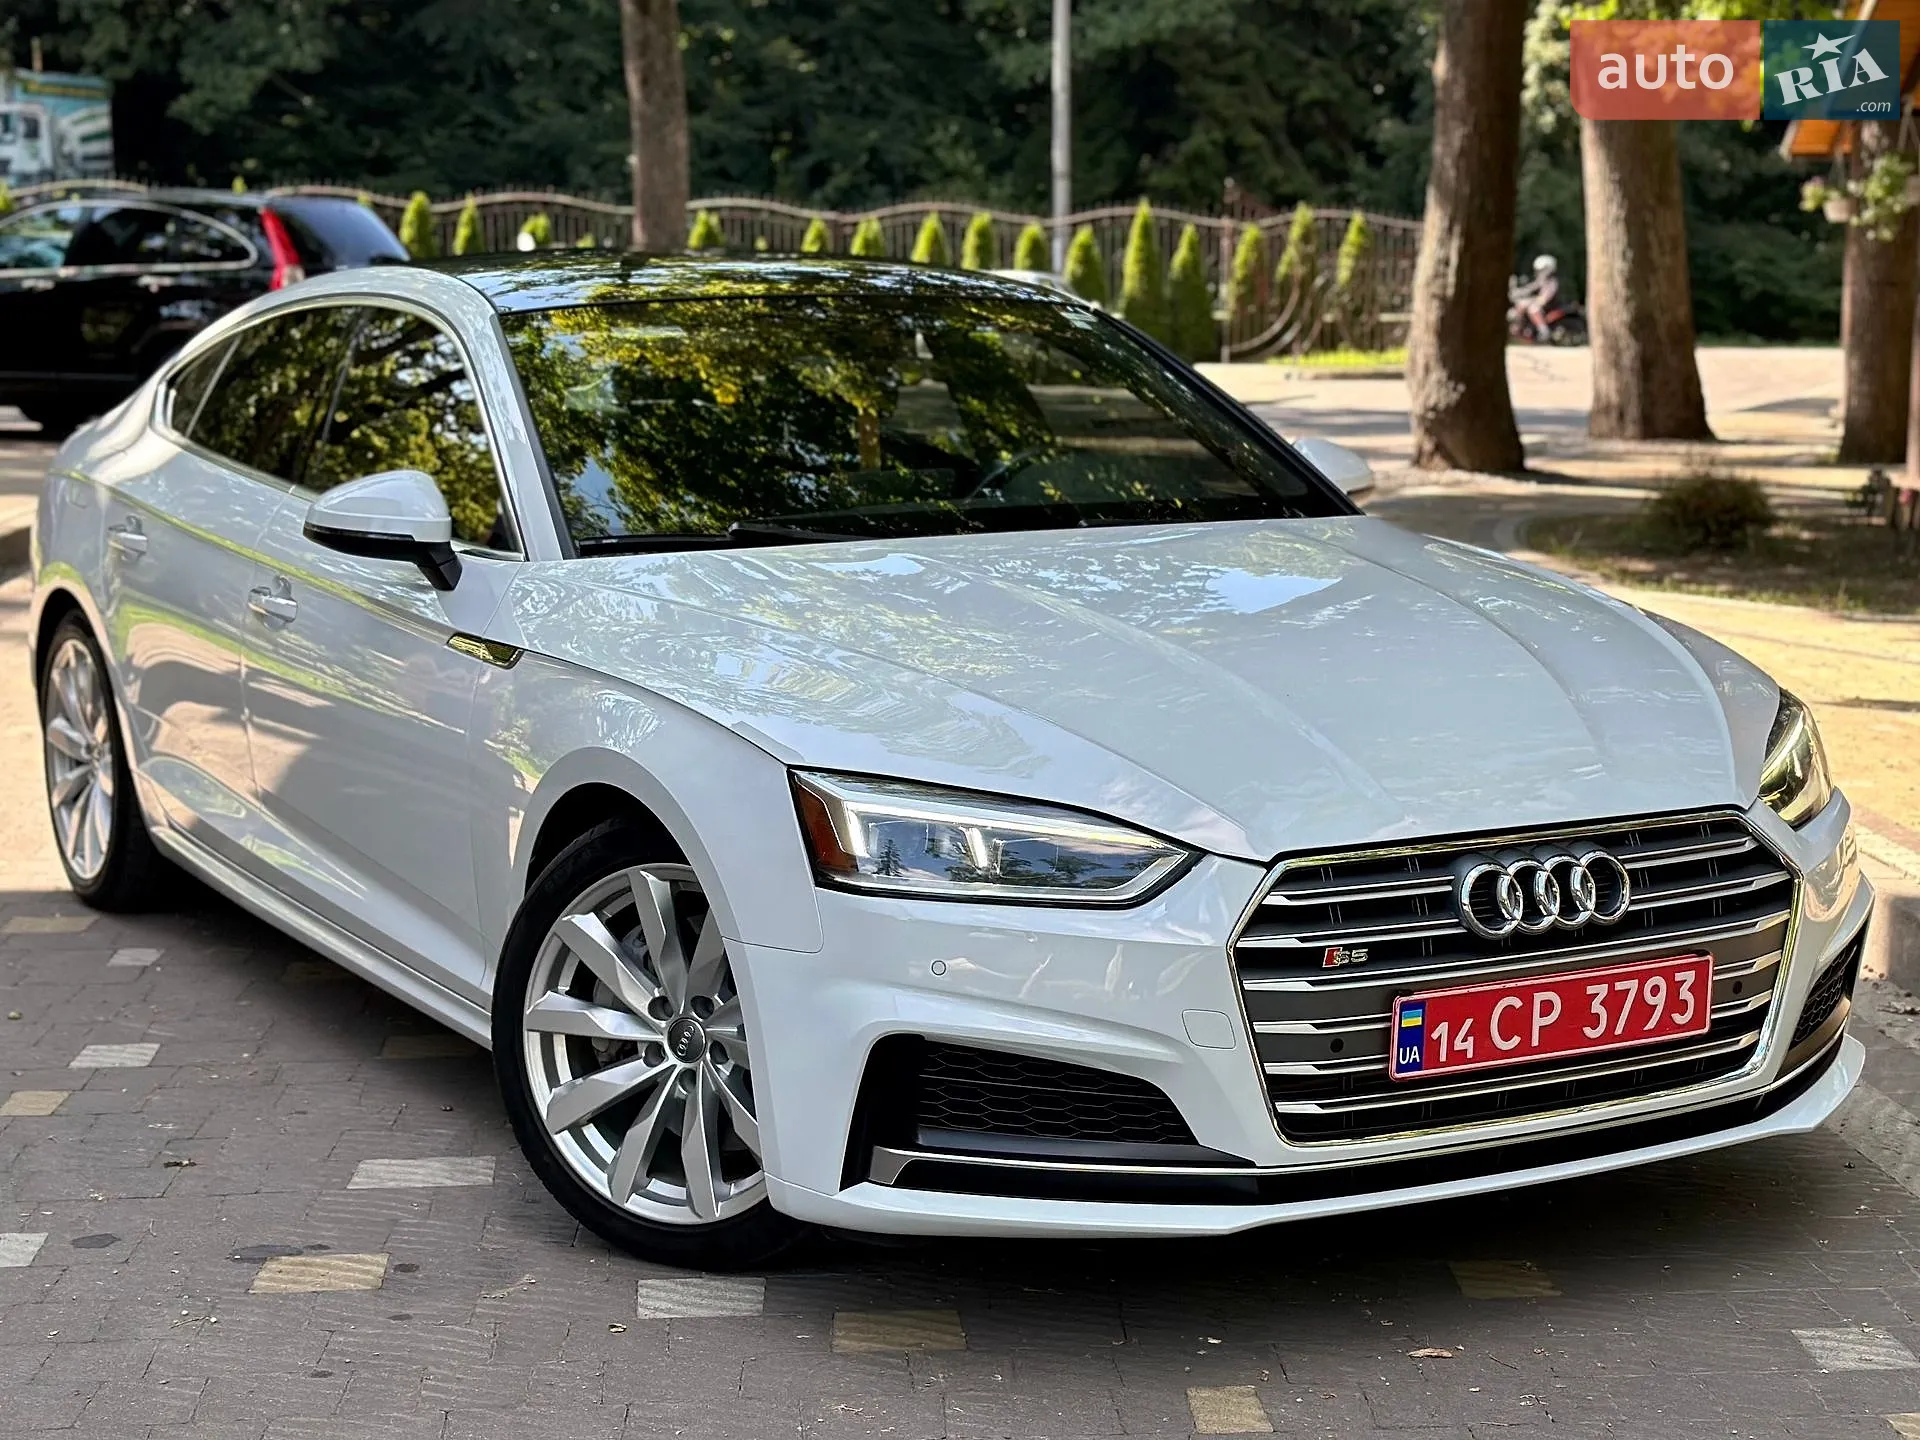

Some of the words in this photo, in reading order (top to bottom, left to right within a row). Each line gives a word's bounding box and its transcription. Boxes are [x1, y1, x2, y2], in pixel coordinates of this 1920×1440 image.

[1431, 1018, 1474, 1062] 14
[1490, 992, 1562, 1051] CP
[1582, 970, 1696, 1040] 3793
[1399, 1045, 1420, 1065] UA
